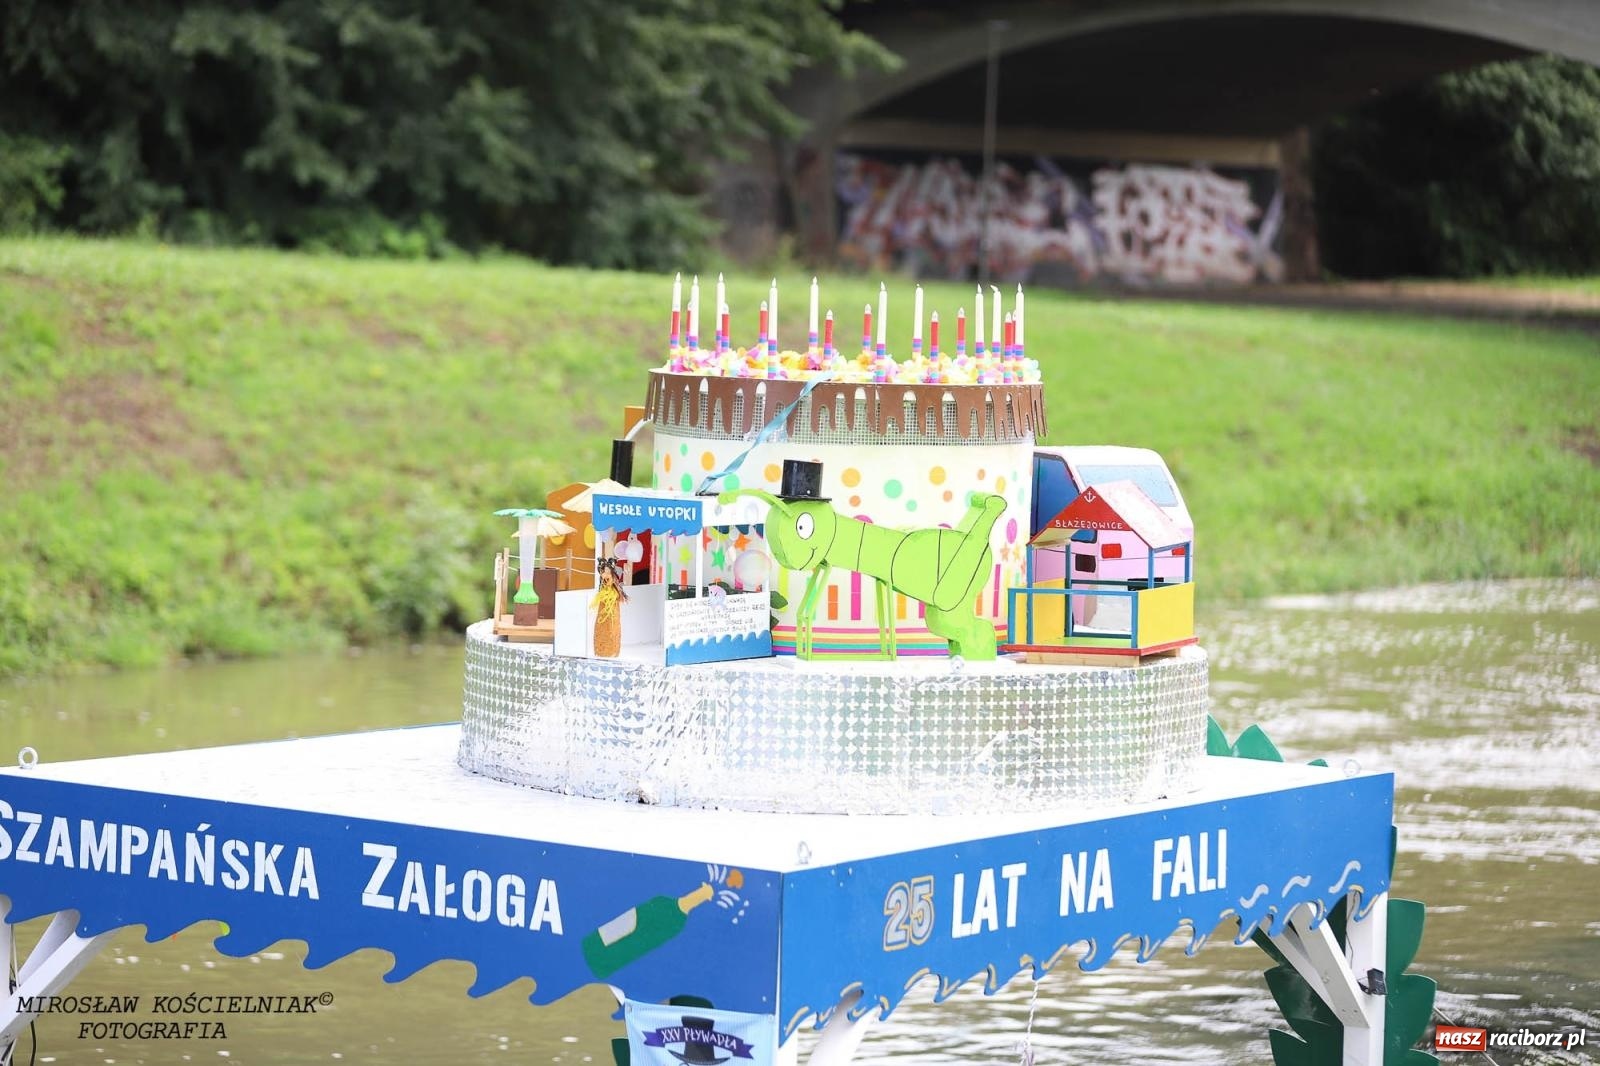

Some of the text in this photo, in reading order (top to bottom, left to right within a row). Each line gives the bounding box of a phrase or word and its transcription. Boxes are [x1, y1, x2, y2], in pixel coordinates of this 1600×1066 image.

[599, 503, 696, 521] WESOŁE UTOPKI
[1055, 517, 1123, 529] BŁAŻEJOWICE
[361, 842, 564, 936] ZAŁOGA
[883, 828, 1227, 952] 25 LAT NA FALI
[660, 1027, 737, 1049] XXV PŁYWADŁA
